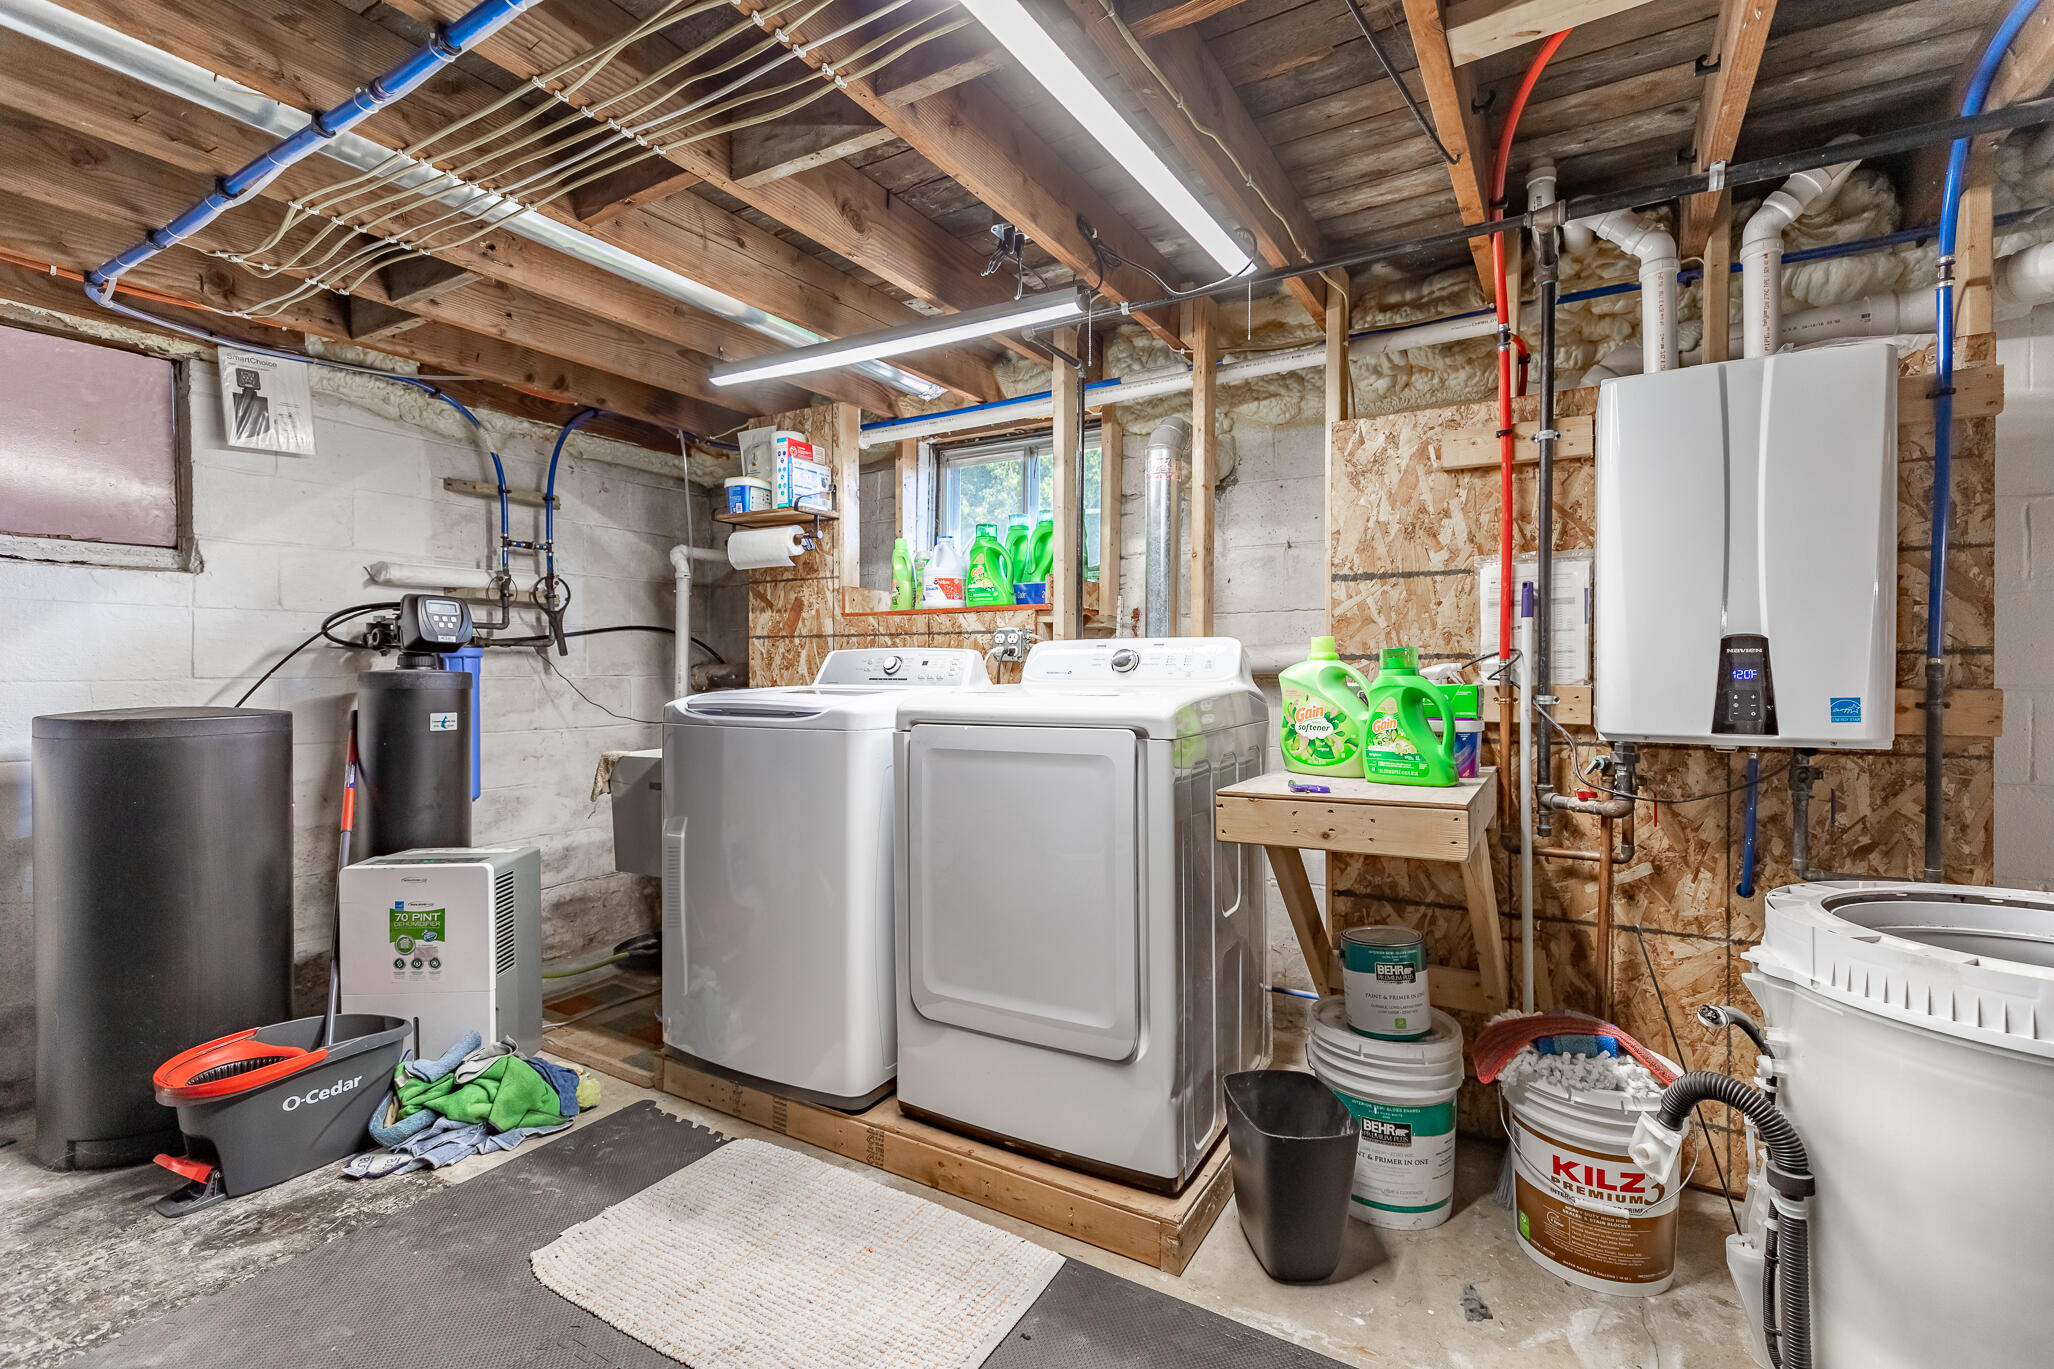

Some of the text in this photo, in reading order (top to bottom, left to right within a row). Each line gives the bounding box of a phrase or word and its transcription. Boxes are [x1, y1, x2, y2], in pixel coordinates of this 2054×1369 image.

[226, 353, 278, 368] SmartChoice
[1295, 705, 1324, 722] Gain
[1298, 723, 1330, 732] softener
[1372, 718, 1397, 733] Gain
[395, 912, 441, 922] 70 PINT
[1376, 964, 1405, 975] BEHR
[1365, 992, 1381, 1000] PAINT
[282, 1075, 362, 1112] O-Cedar
[1363, 1118, 1395, 1136] BEHR
[1362, 1130, 1392, 1141] PREMIUM
[1374, 1156, 1403, 1165] PRIMER
[1552, 1154, 1646, 1194] KILZ
[1551, 1175, 1645, 1205] PREMIUM
[1589, 1218, 1605, 1226] STAIN
